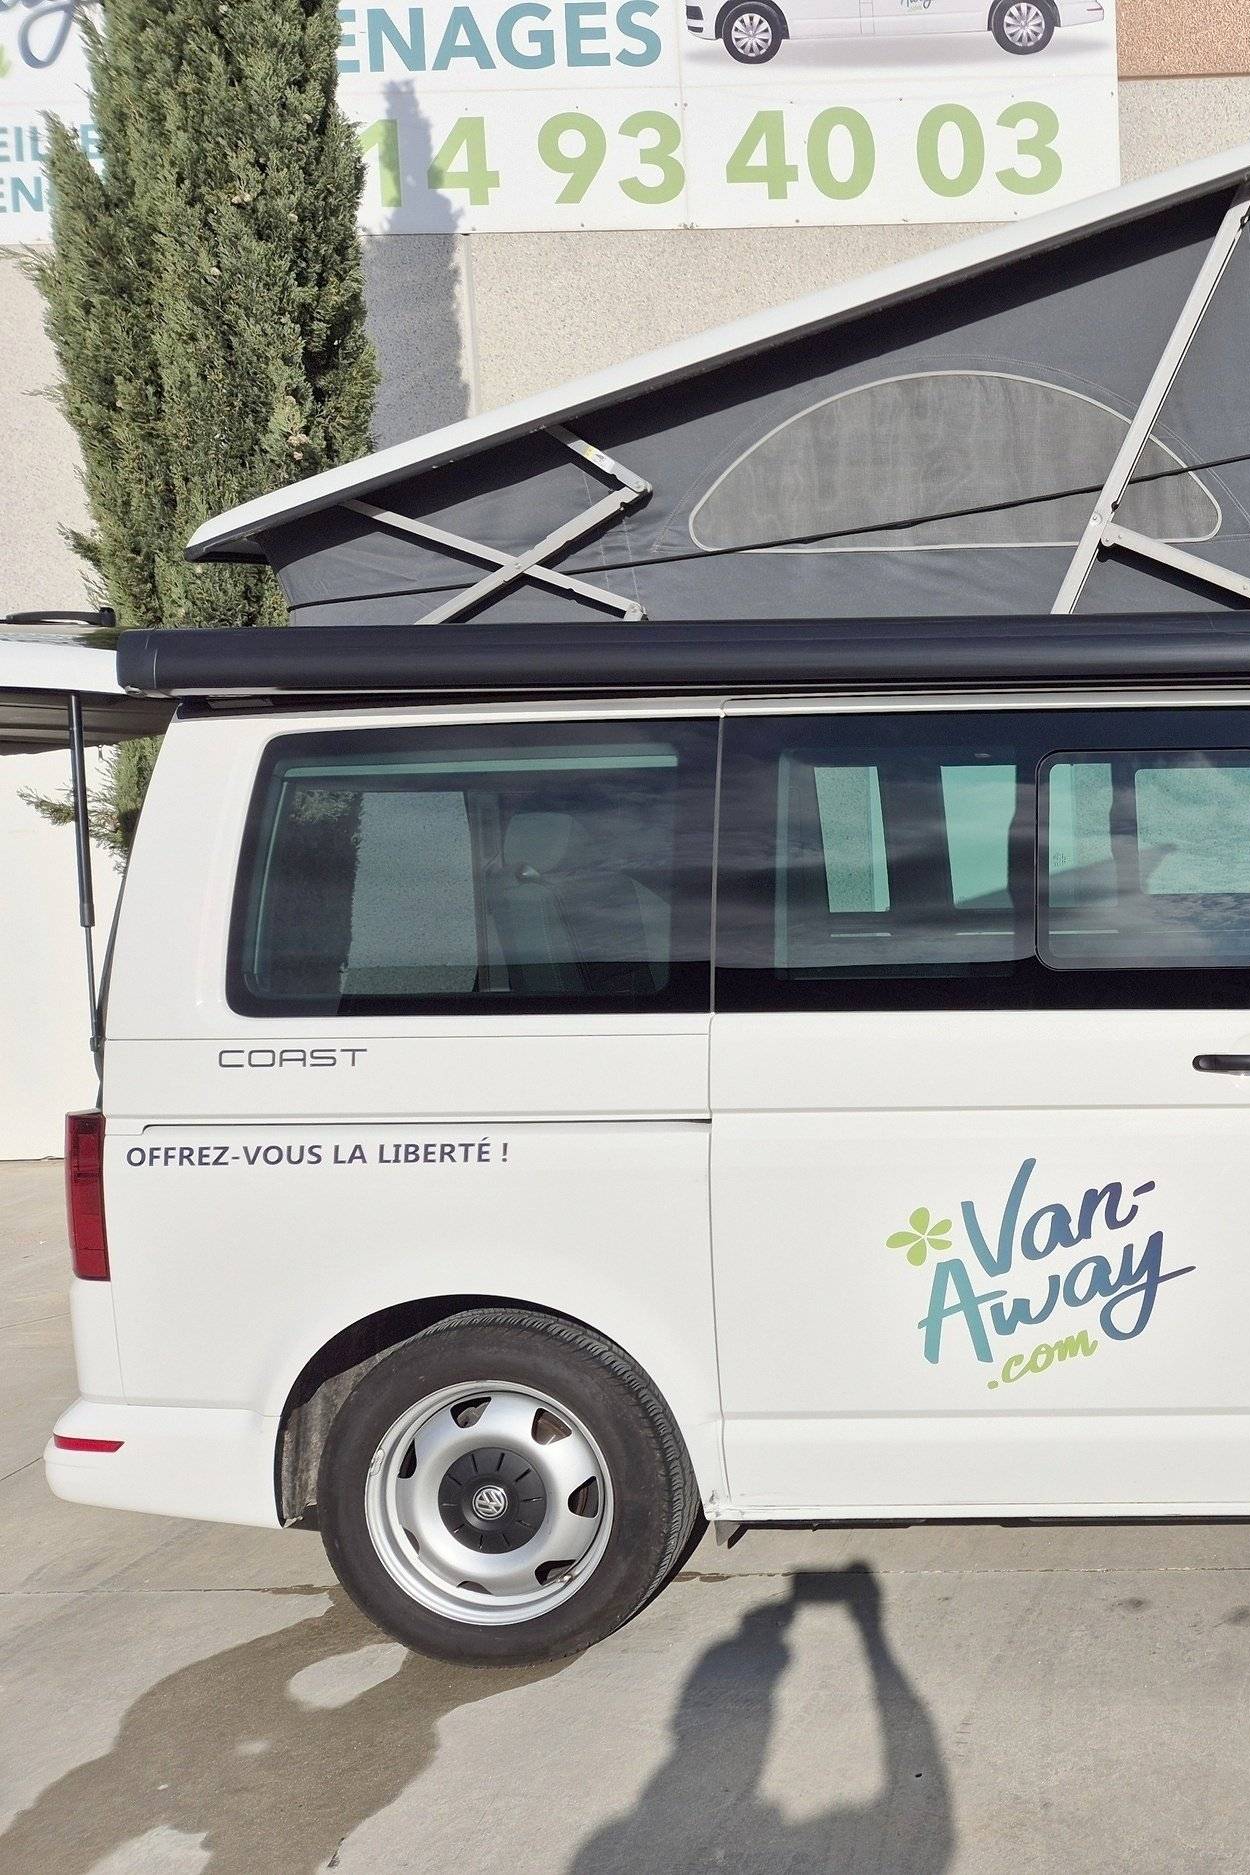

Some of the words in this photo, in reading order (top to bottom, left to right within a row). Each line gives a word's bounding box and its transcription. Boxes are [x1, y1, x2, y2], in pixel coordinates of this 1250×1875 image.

[359, 116, 500, 208] 14
[537, 110, 686, 205] 93
[725, 106, 876, 201] 40
[916, 101, 1063, 198] 03
[218, 1048, 367, 1068] COAST
[126, 1144, 322, 1168] OFFREZ-VOUS
[332, 1144, 367, 1165] LA
[378, 1137, 491, 1164] LIBERTÉ
[501, 1142, 509, 1163] !
[960, 1157, 1156, 1278] Van-
[917, 1230, 1197, 1365] Away
[987, 1329, 1099, 1390] .com
